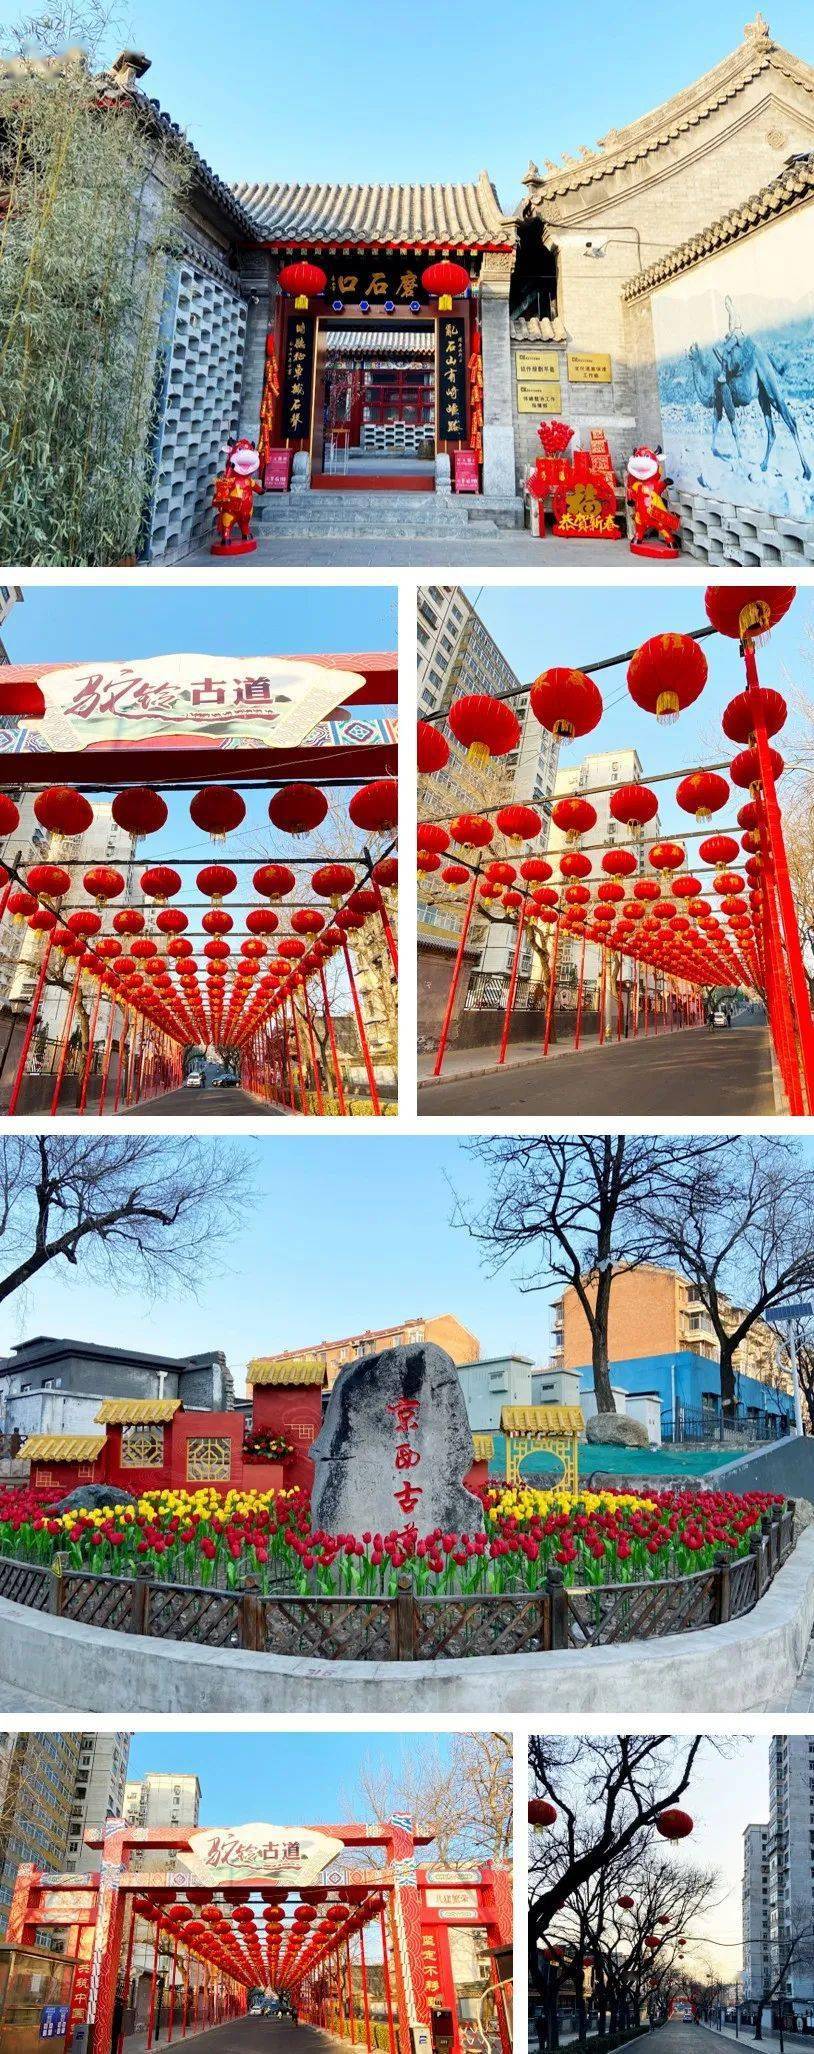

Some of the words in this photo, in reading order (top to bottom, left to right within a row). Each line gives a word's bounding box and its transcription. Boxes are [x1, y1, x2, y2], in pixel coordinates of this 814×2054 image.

[558, 513, 620, 534] 恭贺新春
[64, 669, 274, 720] 驼铃古道
[205, 1833, 301, 1868] 驼铃古道
